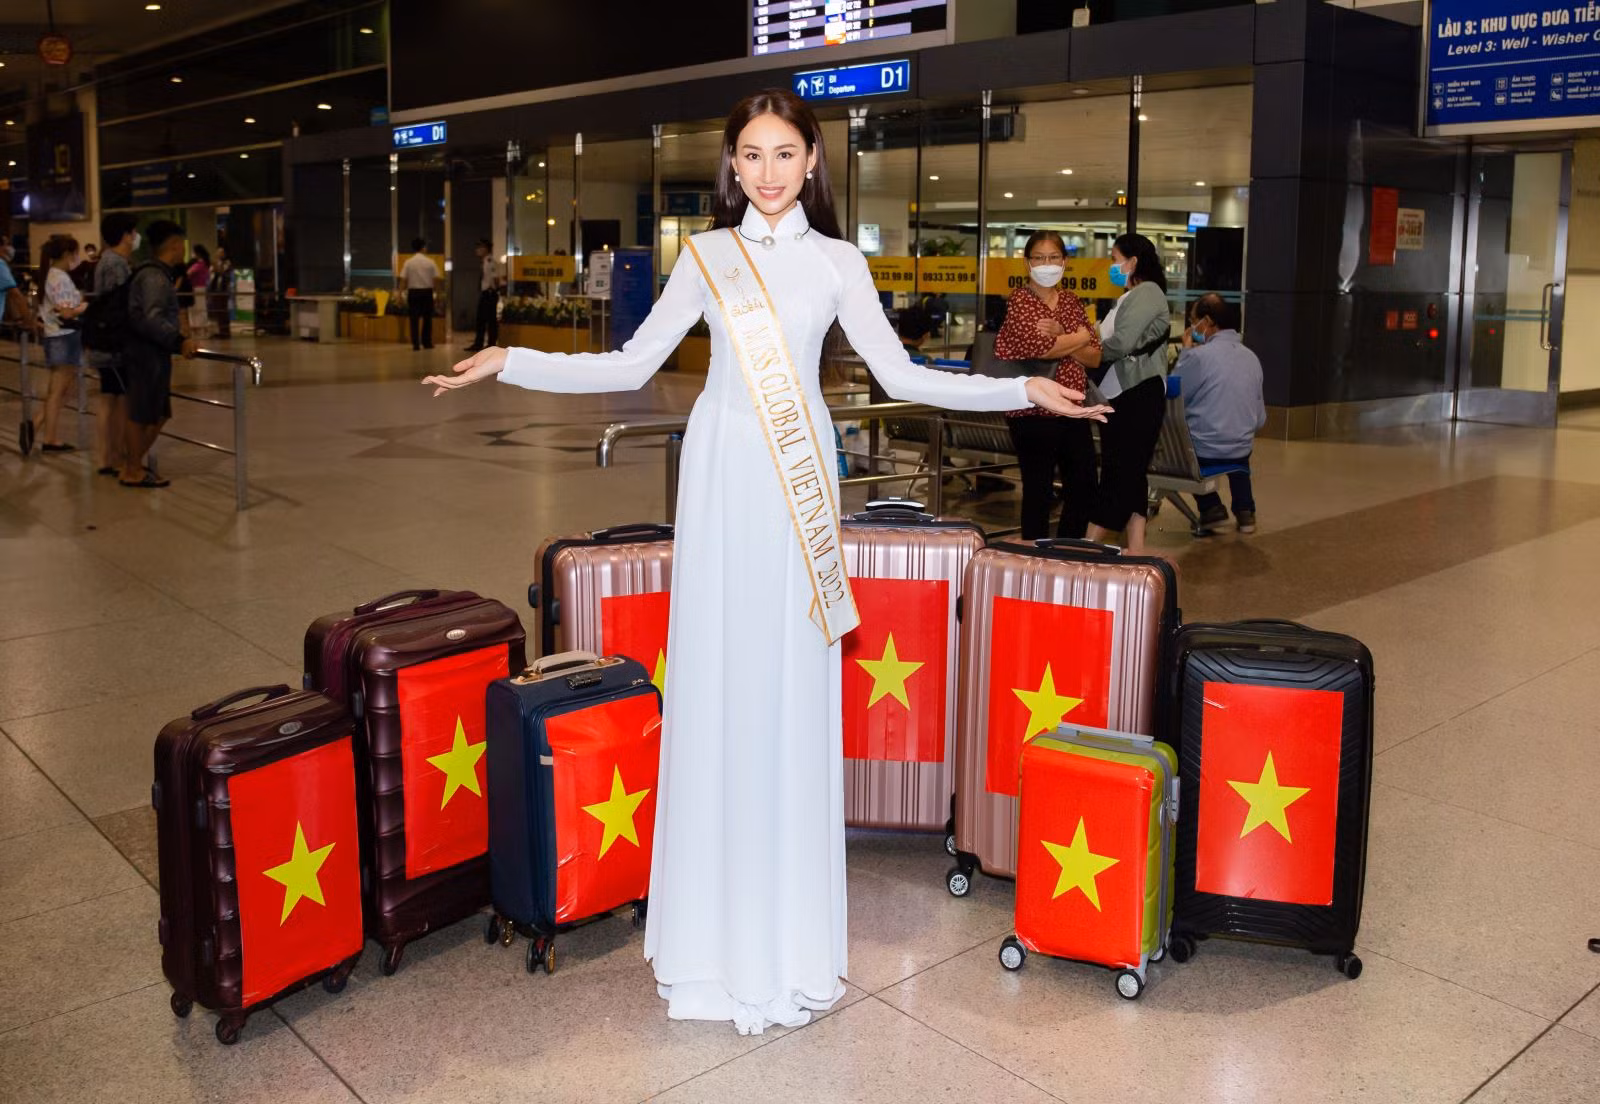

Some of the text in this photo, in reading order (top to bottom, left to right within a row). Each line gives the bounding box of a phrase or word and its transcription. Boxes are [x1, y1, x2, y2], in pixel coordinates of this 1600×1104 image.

[1465, 20, 1477, 35] 3:
[1481, 16, 1507, 33] KHU
[1511, 12, 1537, 32] VỰC
[1448, 42, 1482, 56] Level
[1485, 40, 1497, 52] 3:
[1502, 36, 1529, 50] Well
[1542, 32, 1590, 46] Wisher
[881, 66, 903, 88] D1
[829, 85, 856, 95] Departure
[432, 125, 444, 141] D1
[742, 325, 845, 610] MISS GLOBAL VIETNAM 2022
